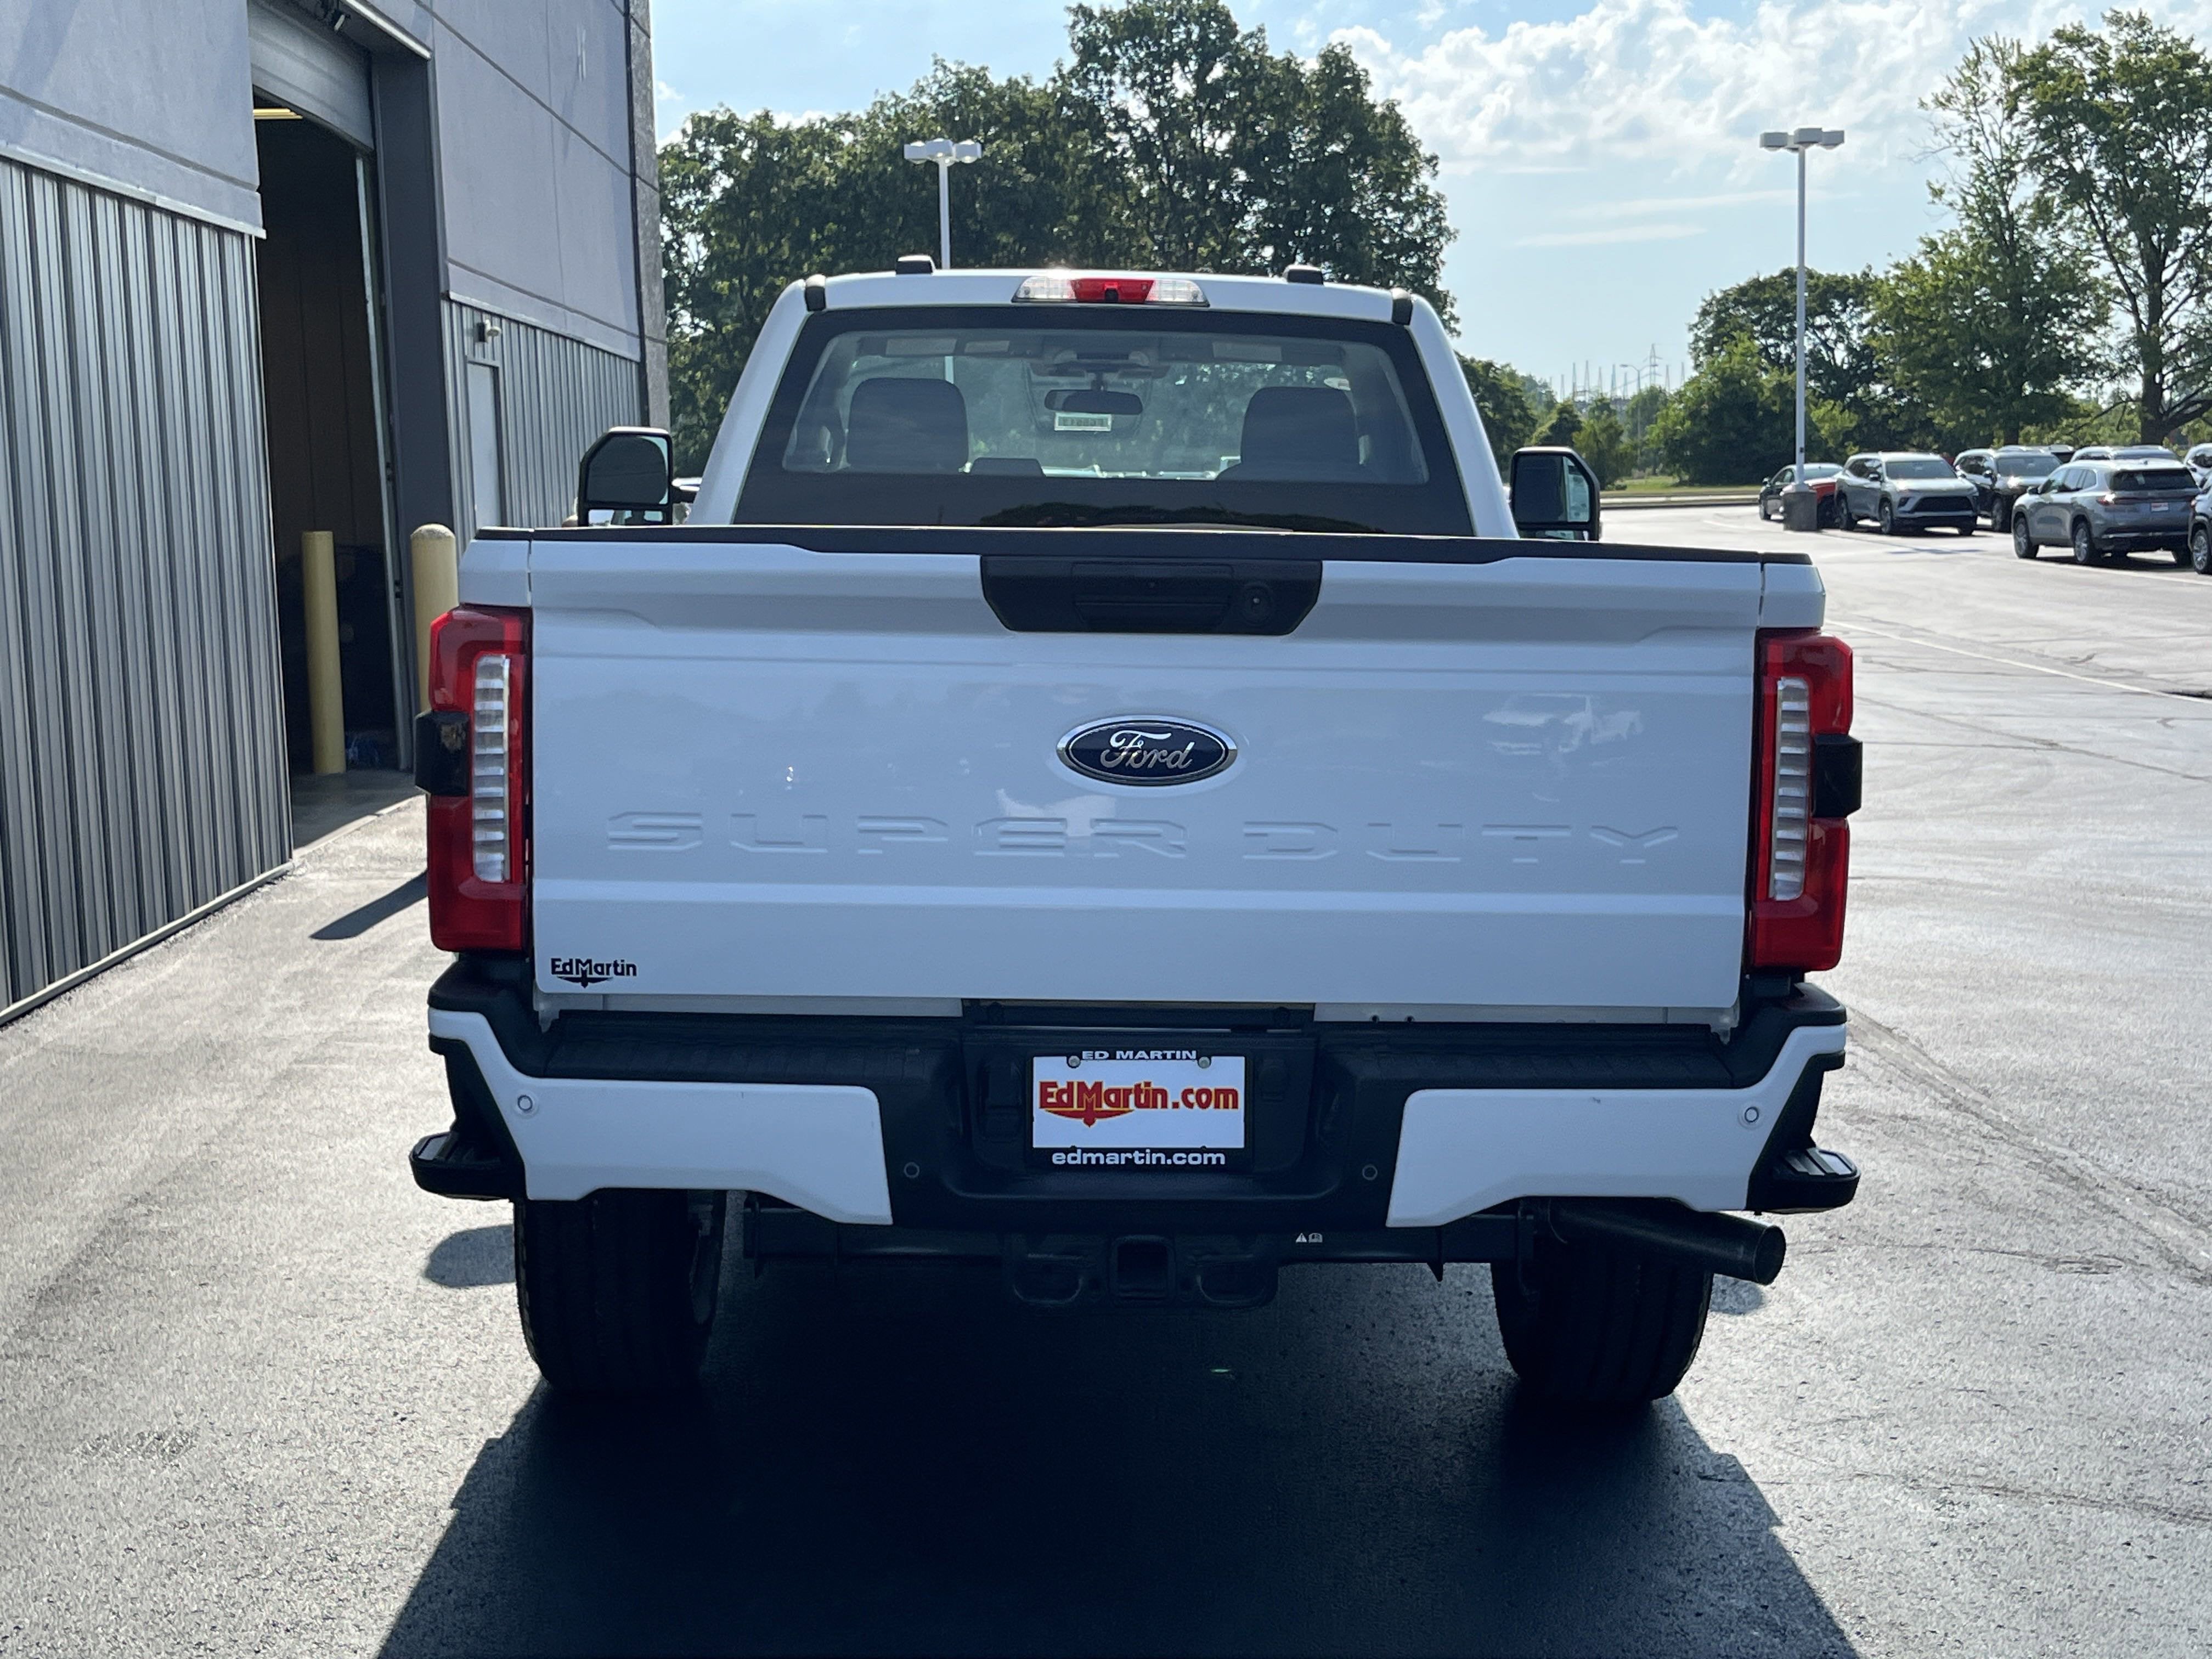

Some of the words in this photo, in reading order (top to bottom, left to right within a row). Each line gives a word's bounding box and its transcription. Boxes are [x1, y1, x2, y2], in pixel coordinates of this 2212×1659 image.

[1099, 730, 1195, 769] Ford
[607, 812, 1188, 859] SUPER
[1242, 821, 1680, 865] DUTY
[550, 958, 637, 977] EdMartin
[1082, 1050, 1109, 1060] ED
[1116, 1050, 1197, 1060] MARTIN
[1039, 1081, 1239, 1110] EdMartin.com
[1052, 1149, 1226, 1165] edmartin.com
